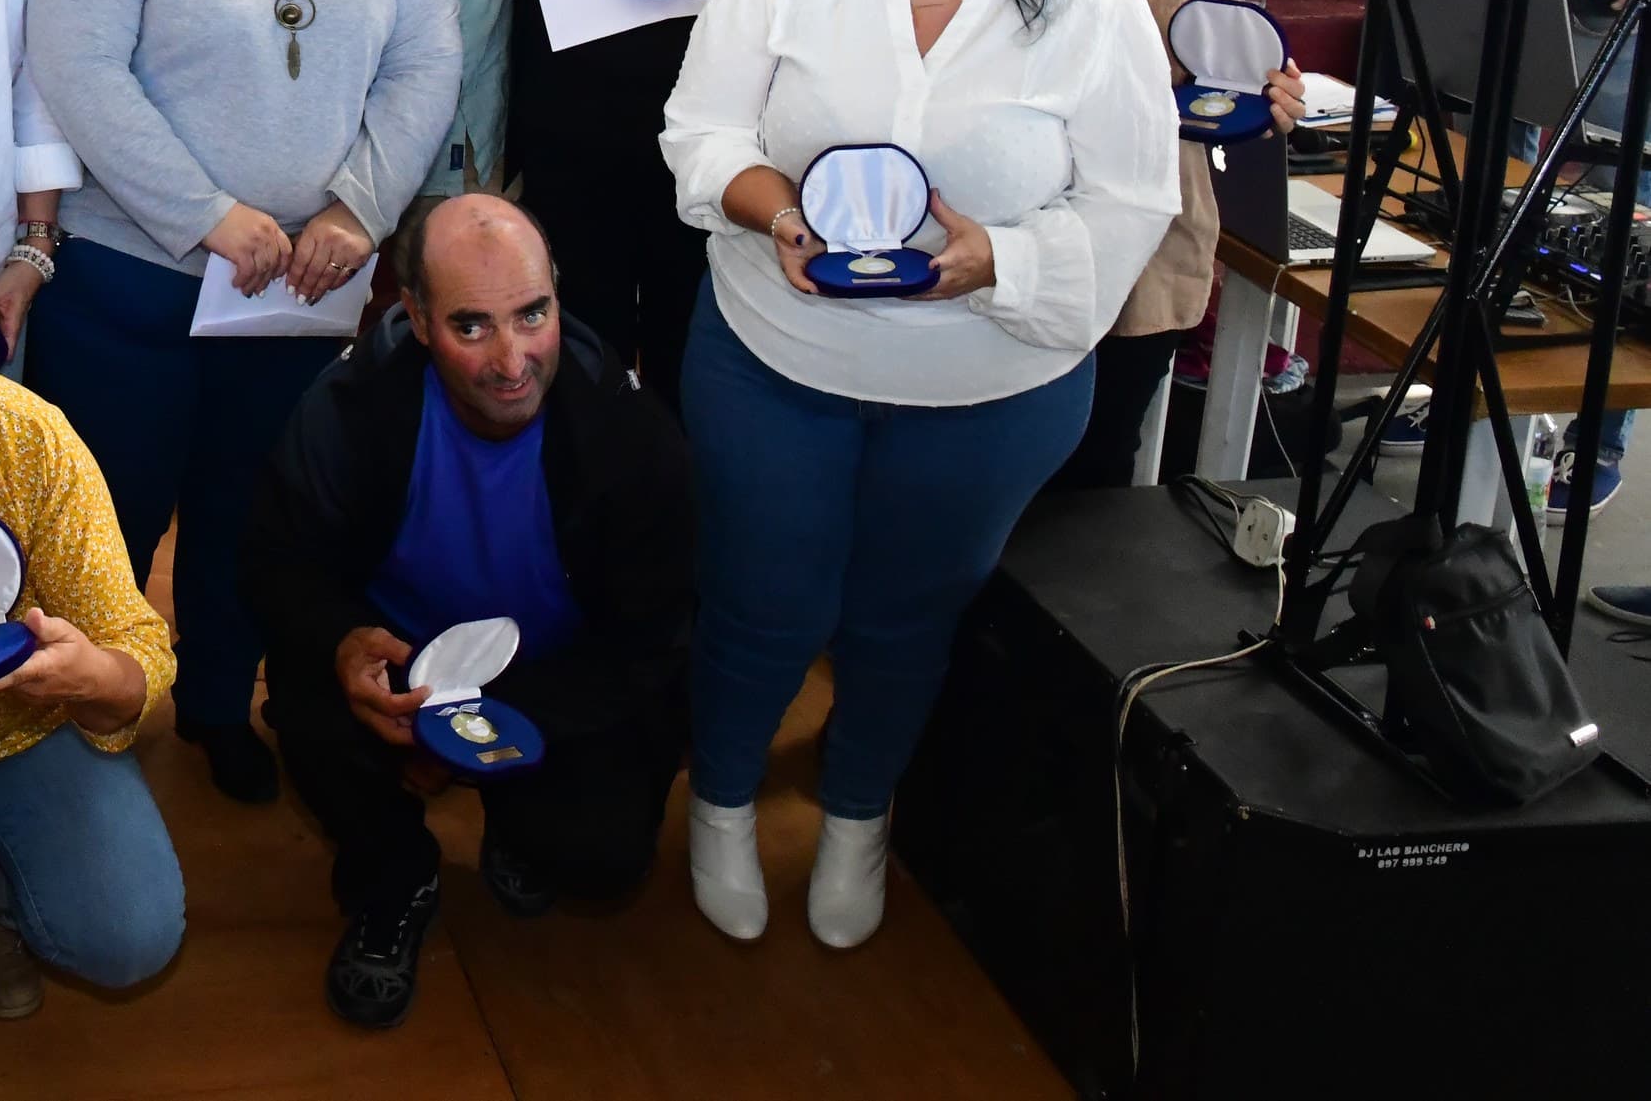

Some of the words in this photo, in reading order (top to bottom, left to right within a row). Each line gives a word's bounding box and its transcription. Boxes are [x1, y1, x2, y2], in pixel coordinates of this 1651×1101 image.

[1358, 848, 1374, 858] DJ
[1404, 843, 1470, 855] BANCHERO
[1377, 859, 1399, 869] 097
[1402, 857, 1423, 867] 999
[1426, 855, 1448, 866] 549
